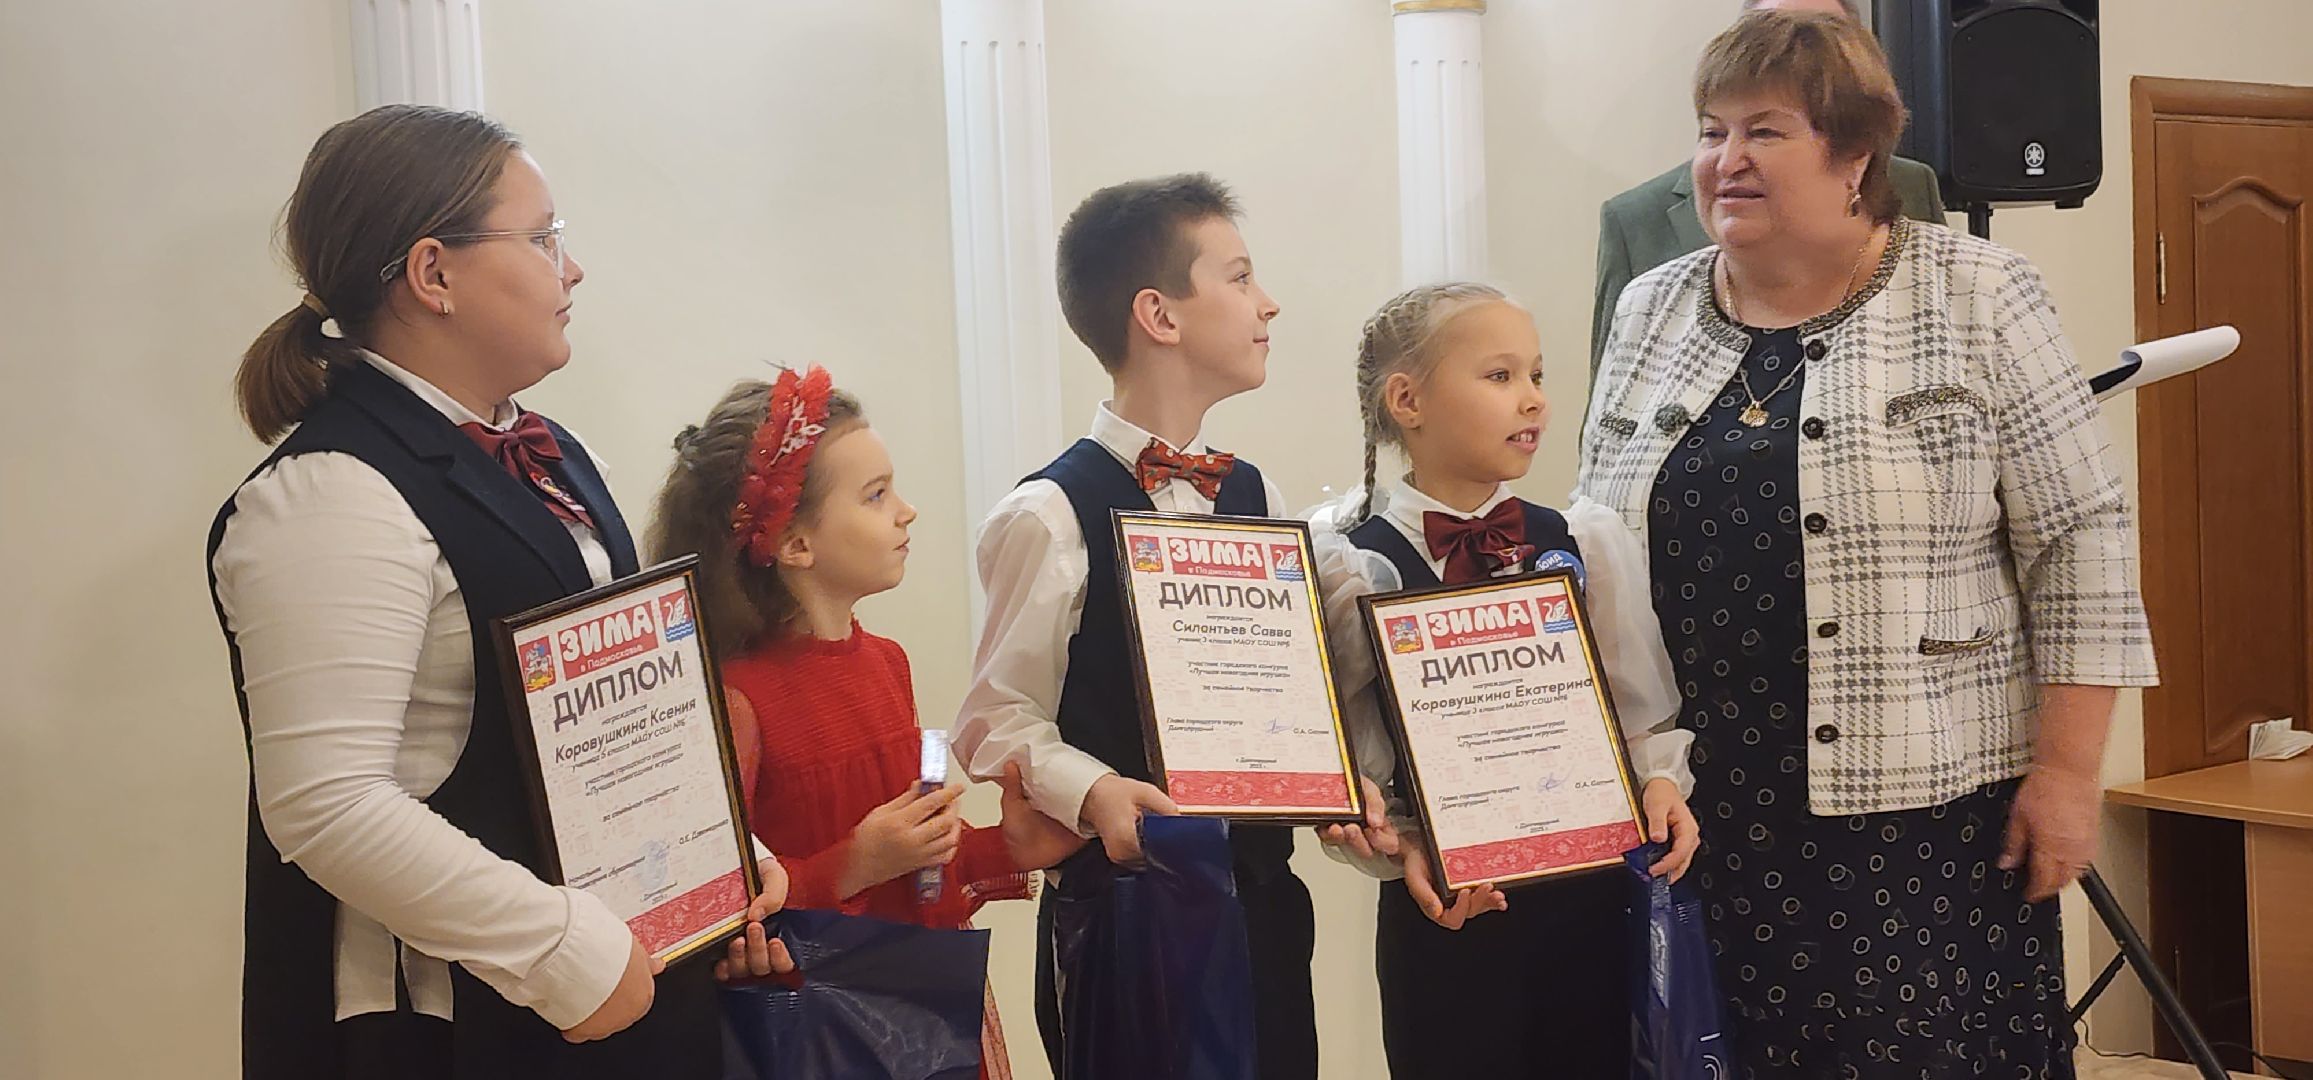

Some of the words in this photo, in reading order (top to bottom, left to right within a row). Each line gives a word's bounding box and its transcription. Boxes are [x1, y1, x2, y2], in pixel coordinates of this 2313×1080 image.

[1168, 539, 1263, 568] ЗИМА
[1195, 567, 1251, 577] Подмосковье
[1159, 581, 1292, 611] ДИПЛОМ
[559, 604, 654, 662] ЗИМА
[1173, 620, 1246, 635] Силантьев
[1250, 624, 1292, 637] Савва
[1427, 602, 1531, 637] ЗИМА
[1457, 631, 1519, 646] Подмосковье
[587, 644, 643, 669] Подмосковье
[1421, 641, 1565, 688] ДИПЛОМ
[553, 651, 683, 732] ДИПЛОМ
[1411, 690, 1510, 712] Коровушкина
[1515, 677, 1593, 698] Екатерина
[1532, 697, 1553, 706] СОШ
[555, 718, 647, 763] Коровушкина
[650, 698, 696, 726] Ксения
